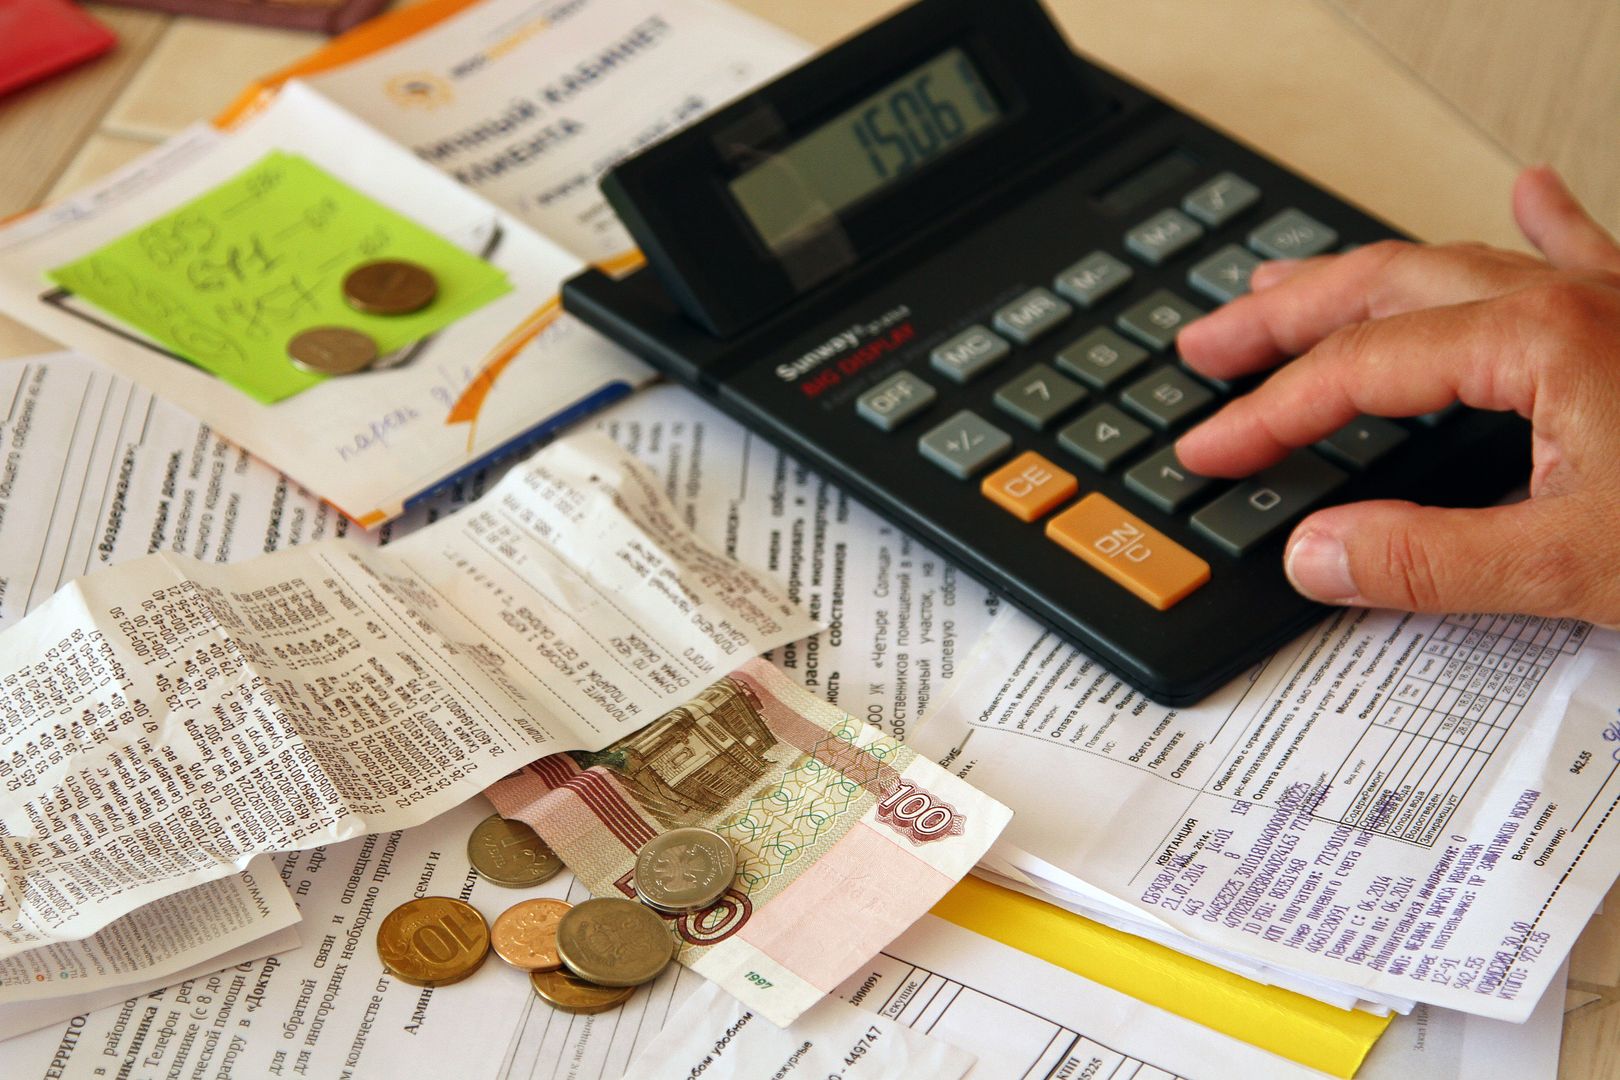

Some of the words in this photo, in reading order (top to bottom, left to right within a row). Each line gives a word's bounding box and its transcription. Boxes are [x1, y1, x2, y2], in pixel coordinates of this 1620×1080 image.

[1024, 380, 1051, 401] 7
[1096, 422, 1121, 442] 4
[1004, 464, 1052, 497] CE
[1250, 489, 1281, 510] 0
[922, 562, 933, 576] на
[826, 542, 847, 647] собственников
[893, 573, 914, 646] помещений
[141, 596, 184, 652] 1.000=49.30
[152, 589, 195, 642] 3.000=92.40
[516, 608, 555, 639] САЛОНОВ
[692, 614, 737, 655] ПОЛУЧЕНО
[719, 620, 748, 646] СДАЧА
[919, 590, 938, 644] участок,
[133, 615, 176, 668] 1.000=17.00
[553, 640, 579, 661] СЕТИ
[610, 638, 632, 657] ЧЕКУ
[626, 634, 661, 663] СКИДОК
[871, 610, 890, 668] «Четыре
[45, 648, 84, 703] 0.550=85.25
[537, 643, 576, 676] КАССИРА
[633, 658, 649, 670] ПО
[660, 663, 689, 687] СУММА
[4, 674, 41, 726] 1.000=90.80
[18, 665, 55, 718] 0.518=20.41
[236, 683, 254, 706] чесн
[260, 689, 276, 706] мол
[586, 670, 627, 703] ПОДАРОК
[648, 670, 678, 694] СУММА
[870, 684, 884, 694] УК
[889, 653, 908, 741] собственников
[1098, 680, 1122, 704] Москва
[1335, 688, 1359, 714] Москва
[212, 703, 236, 731] Домик
[229, 702, 247, 724] Чудо
[582, 685, 629, 722] ПОЛУЧИТЕ
[625, 703, 641, 715] НА
[979, 683, 1011, 722] Общество
[184, 719, 216, 764] Хансдорф
[204, 723, 223, 745] 300г
[253, 707, 283, 749] Сухарики
[272, 706, 299, 739] Десерт
[453, 727, 480, 753] Скидка
[1051, 710, 1078, 738] Оплата
[1128, 742, 1151, 762] Всего
[1153, 709, 1178, 736] оплате:
[137, 737, 153, 755] зел
[161, 746, 177, 762] вес
[219, 746, 242, 774] Батон
[231, 734, 256, 766] Молоко
[245, 726, 270, 758] Йогурт
[1149, 731, 1185, 769] Переплата:
[1171, 741, 1206, 778] Оплачено:
[1213, 755, 1244, 791] Общество
[1245, 699, 1283, 749] ограниченной
[1253, 772, 1279, 800] Оплата
[1275, 712, 1320, 770] коммунальных
[1316, 689, 1335, 711] услуг
[106, 752, 137, 790] красный
[121, 745, 151, 783] Витамин
[147, 757, 183, 803] Сельдерей
[172, 764, 198, 796] Томаты
[189, 762, 207, 780] РУБ
[211, 764, 227, 782] Сыр
[63, 776, 90, 809] Просто
[80, 768, 105, 800] коротк
[100, 780, 140, 826] Нектарины
[146, 785, 169, 812] Салат
[201, 781, 222, 803] 0.08
[1343, 771, 1385, 824] СодержРемонт
[100, 802, 125, 832] Огурцы
[131, 791, 155, 820] Перец
[878, 783, 954, 841] 100
[1512, 838, 1533, 860] Всего
[1534, 802, 1558, 830] оплате:
[1570, 751, 1592, 774] 942,55
[68, 813, 96, 846] Маслины
[85, 813, 109, 838] Творог
[230, 823, 255, 852] Скидка
[1156, 818, 1198, 867] КВИТАНЦИЯ
[1161, 863, 1207, 910] 21.07.2014
[1205, 829, 1234, 853] 14:01
[1230, 800, 1253, 816] 158
[1534, 827, 1567, 866] Оплачено:
[414, 862, 436, 899] семьи
[429, 850, 440, 860] и
[1268, 859, 1308, 899] 80351968
[1182, 898, 1205, 915] 443
[1202, 878, 1244, 922] 044525225
[1262, 925, 1286, 942] КПП
[1279, 871, 1323, 924] получателя:
[1283, 924, 1312, 949] Номер
[1306, 880, 1342, 920] лицевого
[1335, 851, 1362, 877] счета
[1367, 901, 1425, 971] Дополнительная
[1417, 846, 1459, 899] информация:
[1404, 922, 1435, 951] ФЕДИНА
[1425, 887, 1458, 917] ЛАРИСА
[1446, 844, 1485, 883] ИВАНОВНА
[332, 915, 343, 924] и
[341, 887, 380, 960] необходимо
[411, 905, 483, 965] 10
[1305, 905, 1350, 953] 4060120091
[1325, 929, 1358, 959] Период
[1357, 876, 1393, 911] 06.2014
[1346, 935, 1379, 965] Период
[1371, 916, 1389, 932] по:
[1382, 877, 1416, 912] 06.2014
[1409, 954, 1438, 981] Адрес
[1431, 891, 1476, 950] плательщика:
[1467, 875, 1486, 886] ПР
[1452, 957, 1486, 990] 942.55
[1475, 952, 1517, 995] КОМИССИЯ
[1501, 922, 1533, 949] 30.00
[1496, 968, 1528, 1000] ИТОГО:
[1518, 932, 1551, 963] 972.55
[197, 994, 211, 1004] 8
[205, 974, 220, 993] до
[245, 955, 280, 1012] «Доктор
[744, 970, 774, 991] 1997
[880, 980, 919, 1019] Текущие
[214, 975, 245, 1027] помощи
[269, 1050, 287, 1076] для
[283, 979, 317, 1039] обратной
[314, 934, 336, 968] связи
[294, 1050, 312, 1075] для
[305, 963, 348, 1046] иногородних
[143, 1011, 181, 1067] Телефон
[345, 995, 383, 1067] количестве
[376, 978, 389, 992] от
[713, 1011, 754, 1058] удобном
[843, 1024, 884, 1067] 449747
